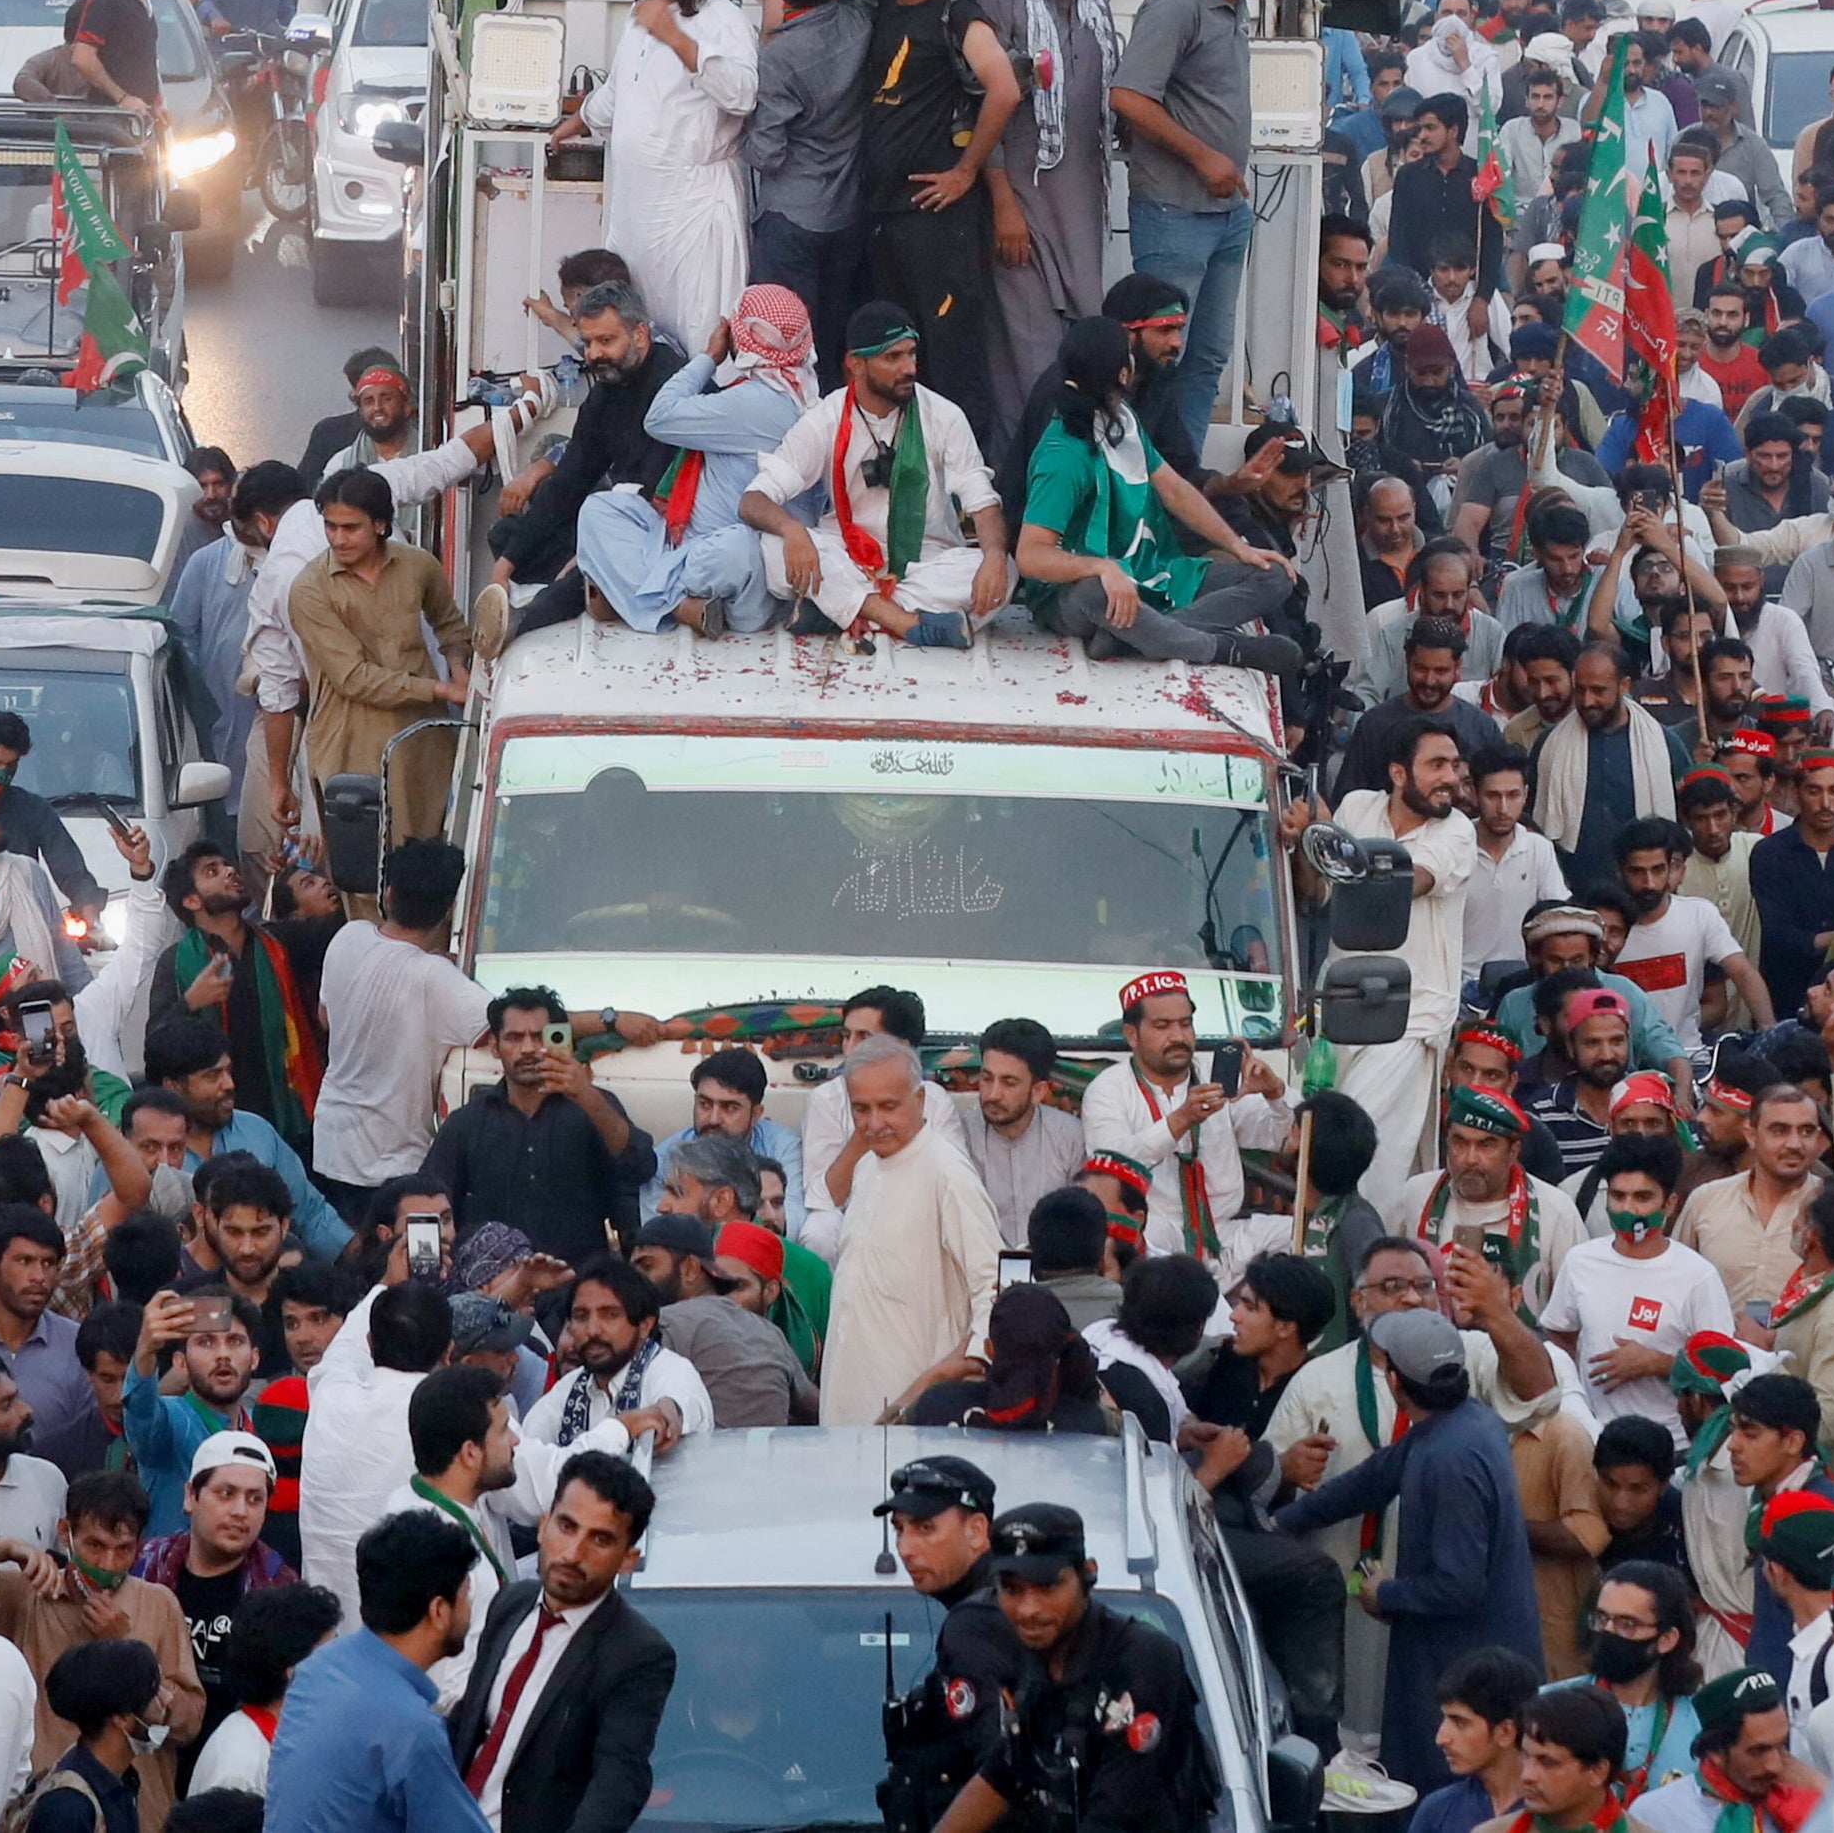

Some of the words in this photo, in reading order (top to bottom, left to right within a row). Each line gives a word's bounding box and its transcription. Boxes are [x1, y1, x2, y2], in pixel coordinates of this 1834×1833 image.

[66, 169, 104, 213] YOUTH
[100, 214, 127, 250] WING
[1128, 974, 1161, 1001] P.T.I
[1464, 1113, 1491, 1131] P.T.I
[1631, 1303, 1656, 1323] بول
